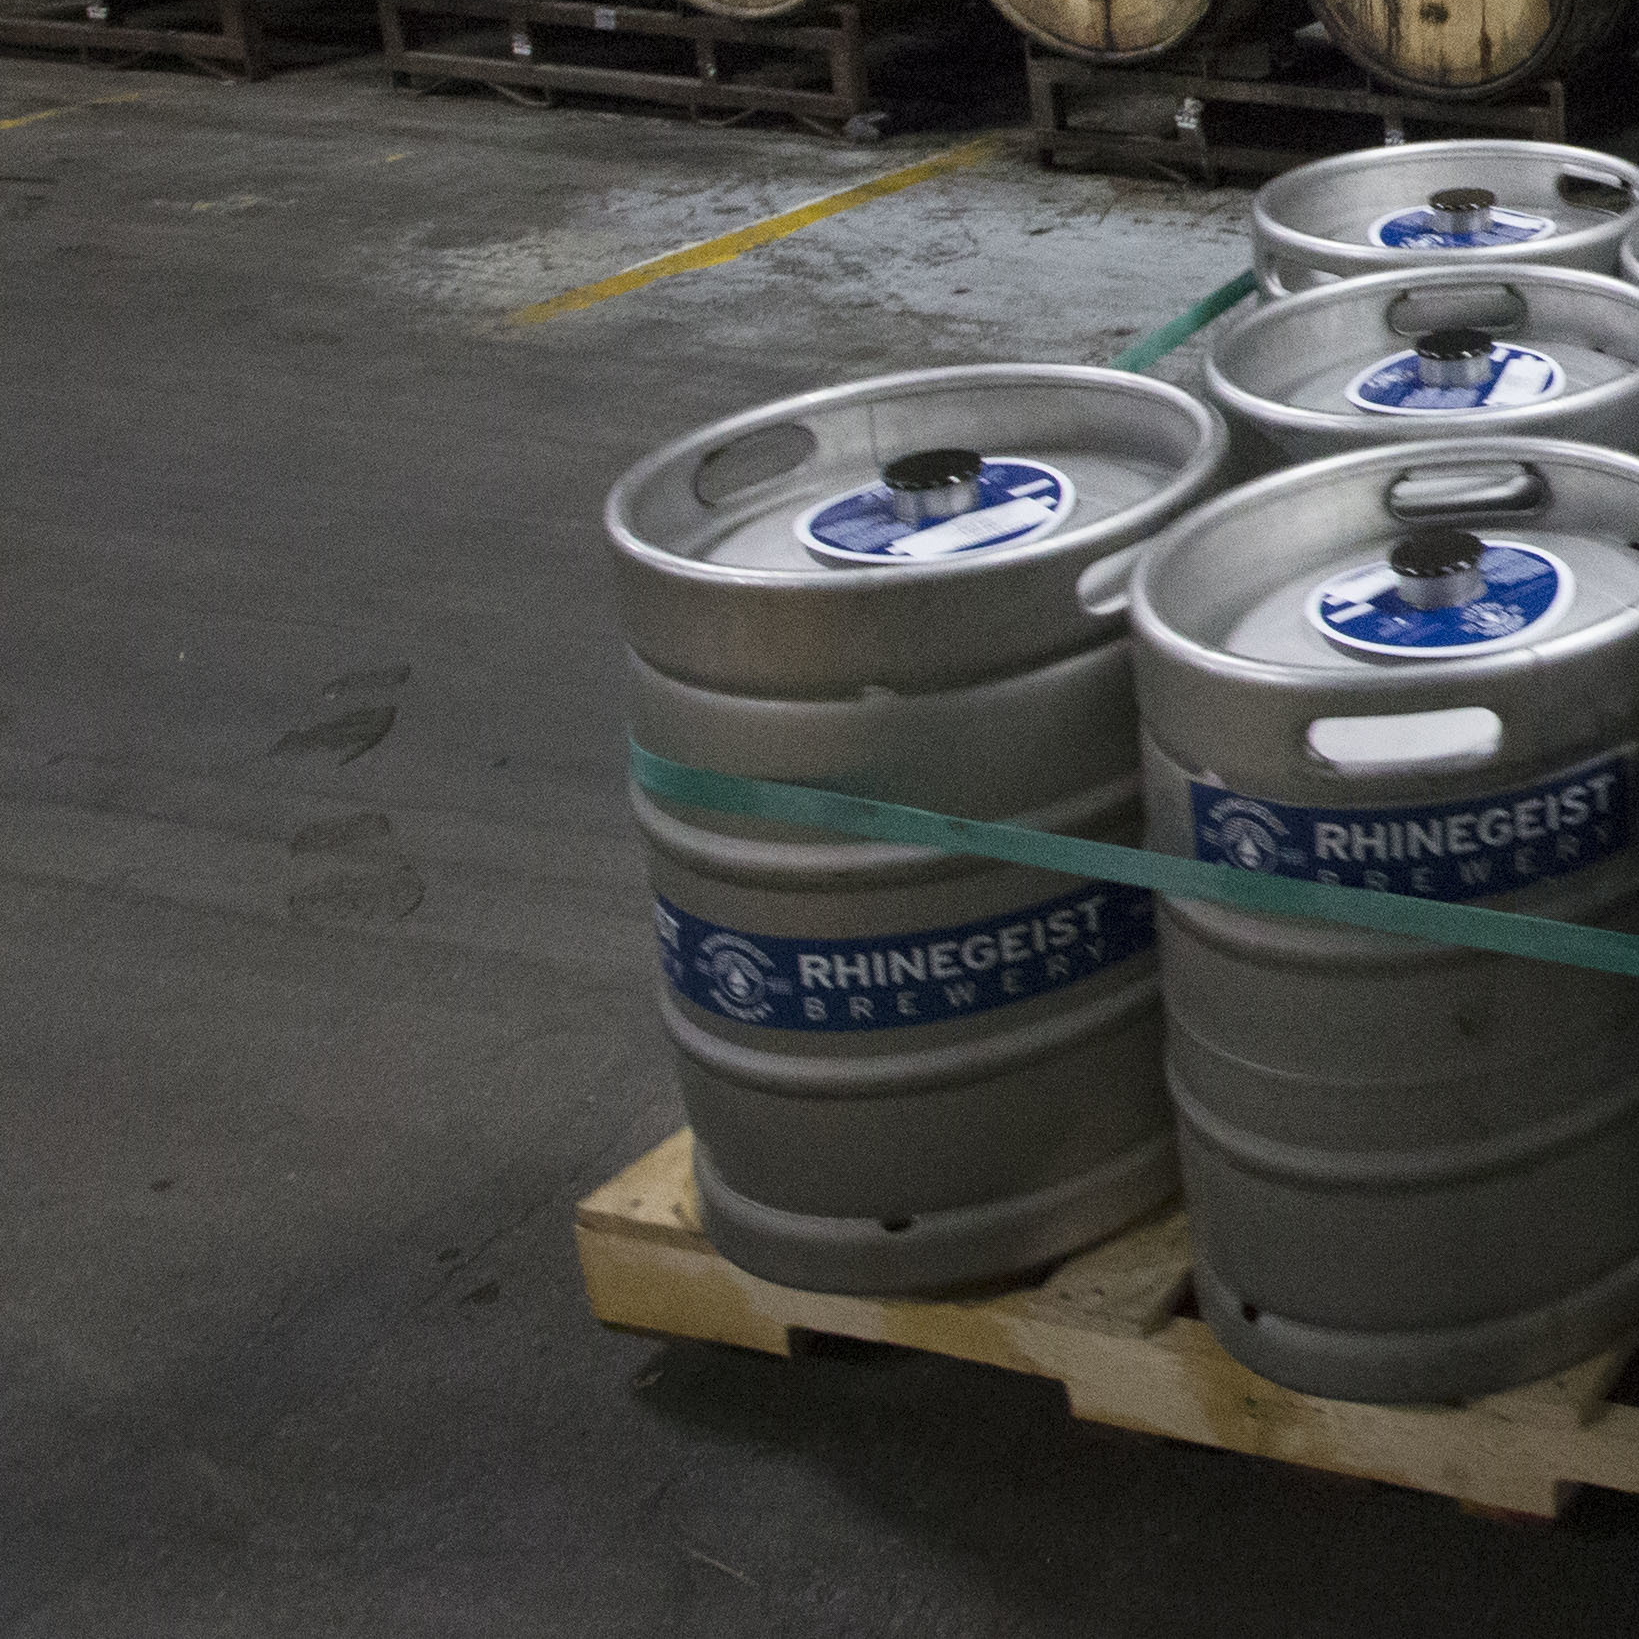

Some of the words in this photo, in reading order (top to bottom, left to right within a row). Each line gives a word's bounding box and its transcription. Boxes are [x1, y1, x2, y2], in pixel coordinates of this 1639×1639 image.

[1314, 773, 1618, 861] RHINEGEIST
[798, 896, 1104, 990] RHINEGEIST
[802, 938, 1107, 1022] BREWERY
